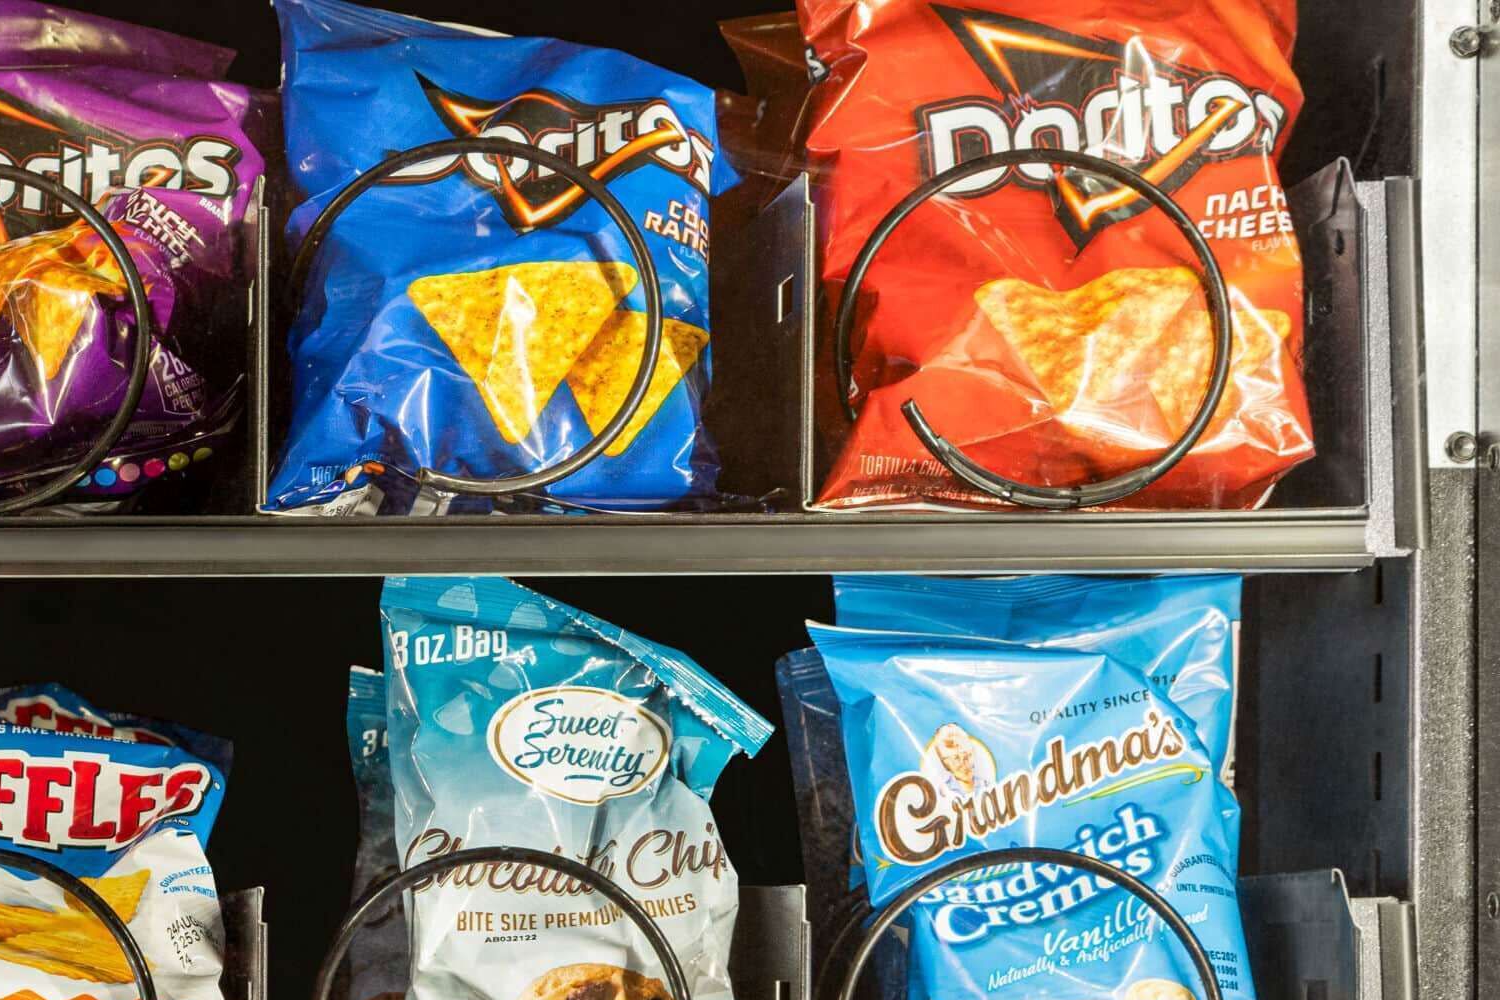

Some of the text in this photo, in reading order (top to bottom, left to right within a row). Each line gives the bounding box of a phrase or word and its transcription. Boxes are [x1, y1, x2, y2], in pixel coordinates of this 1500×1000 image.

[928, 76, 1287, 196] Doritos
[860, 455, 917, 477] TORTILLA
[391, 631, 410, 669] 3
[527, 698, 638, 740] Sweet
[1102, 688, 1152, 711] SINCE
[514, 732, 648, 788] Serenity
[876, 712, 1185, 866] Grandma's
[916, 805, 1162, 905] Sandwich
[934, 847, 1152, 944] Cremes
[1176, 883, 1199, 893] UNTIL
[456, 907, 624, 932] BITE SIZE PREMIUM
[484, 933, 538, 944] AB032122
[1043, 894, 1157, 956] Vanilla
[987, 920, 1154, 992] Naturally & Artificially
